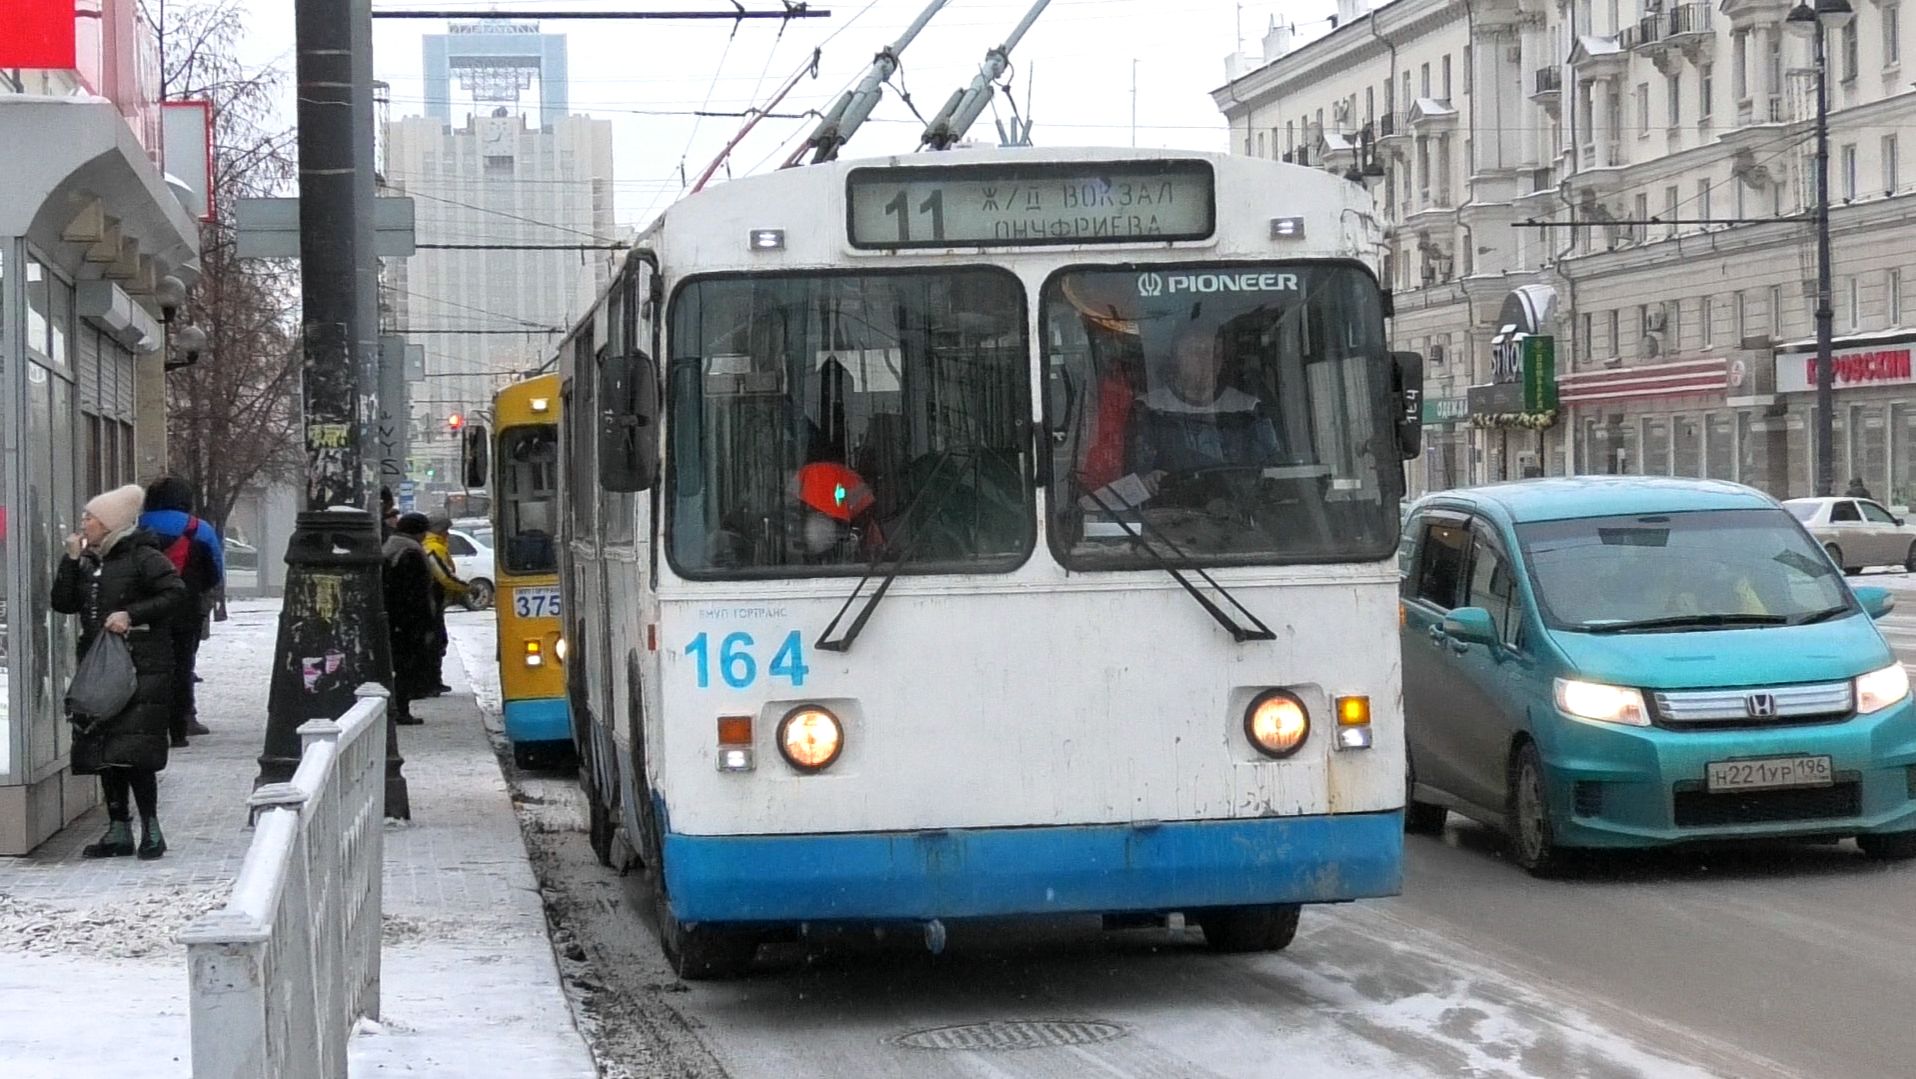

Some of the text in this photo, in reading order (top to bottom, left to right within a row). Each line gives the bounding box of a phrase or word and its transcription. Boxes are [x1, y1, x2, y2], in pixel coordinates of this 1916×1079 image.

[1062, 181, 1173, 208] ВОКЗАЛ
[885, 188, 945, 241] 11
[1168, 273, 1298, 293] PIONEER
[1806, 350, 1911, 385] КРОВСКИЙ
[516, 594, 561, 617] 375
[733, 606, 788, 619] ГОРТРАНС
[684, 629, 810, 689] 164
[1715, 758, 1825, 786] Н221УР 196
